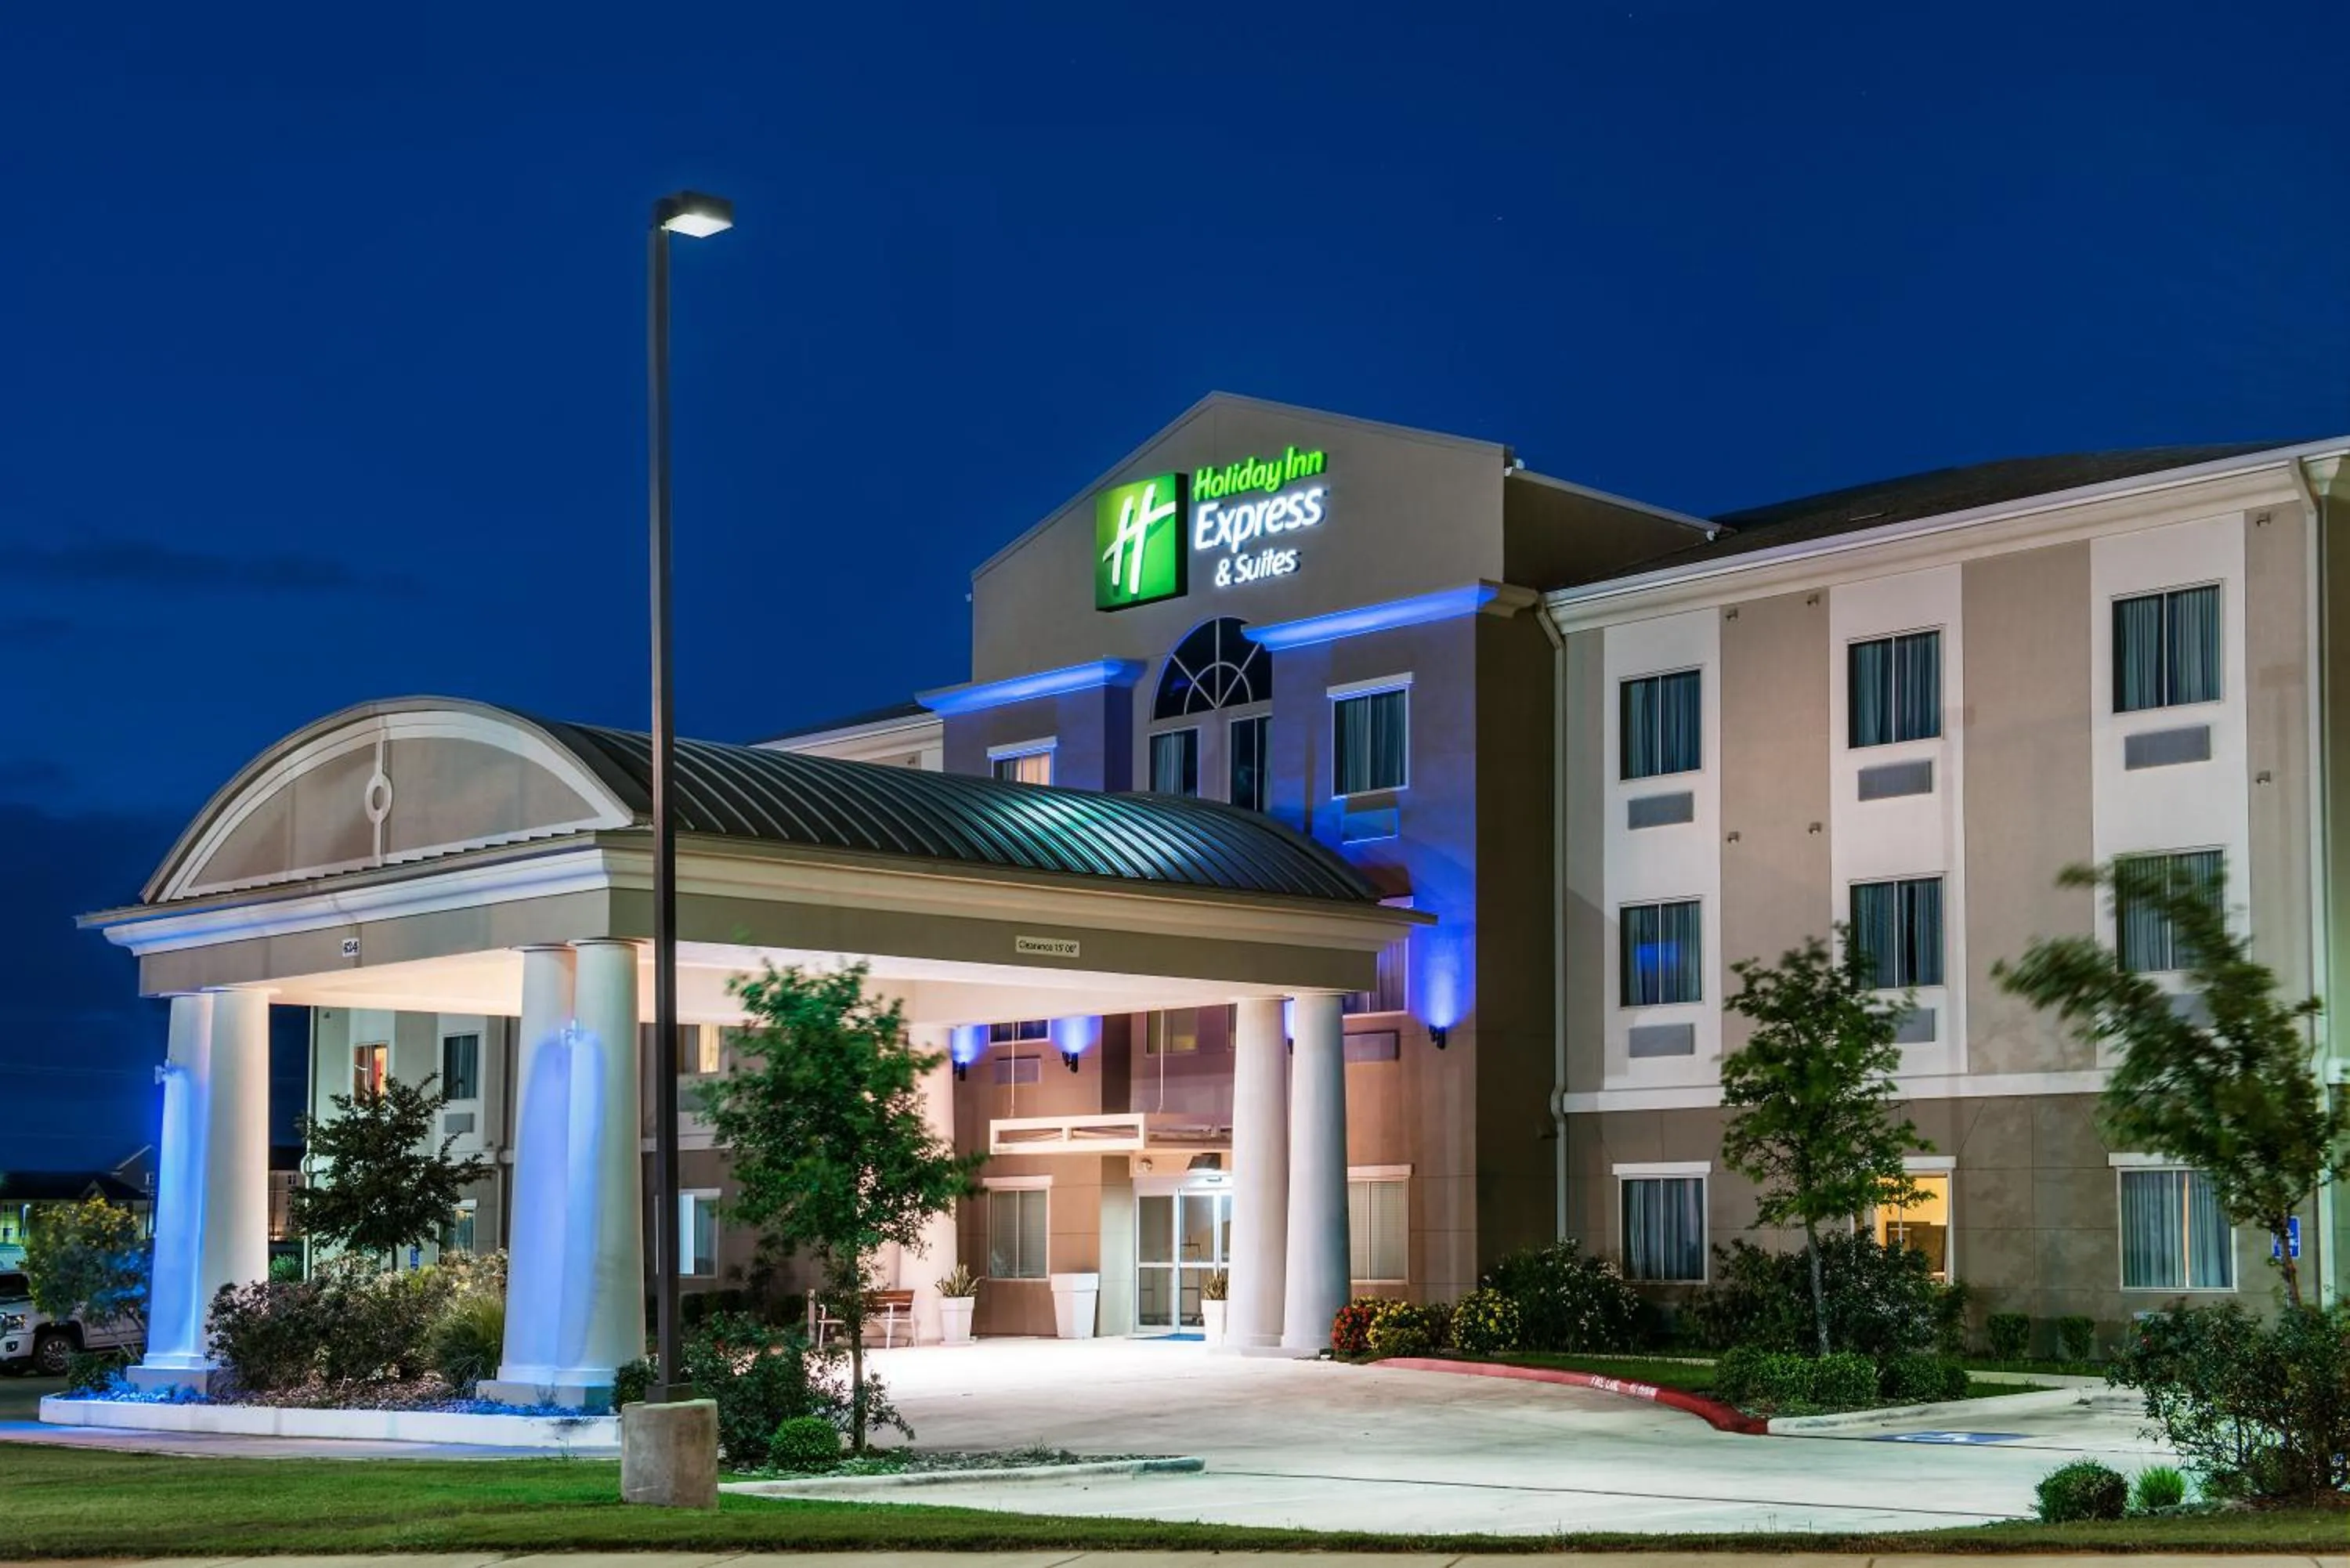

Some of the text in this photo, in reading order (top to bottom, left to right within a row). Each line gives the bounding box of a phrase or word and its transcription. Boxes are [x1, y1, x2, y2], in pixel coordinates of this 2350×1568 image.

[1193, 446, 1327, 501] Holiday Inn
[1195, 488, 1325, 553] Express
[1215, 548, 1299, 587] & Suites
[1018, 939, 1053, 952] Clearance
